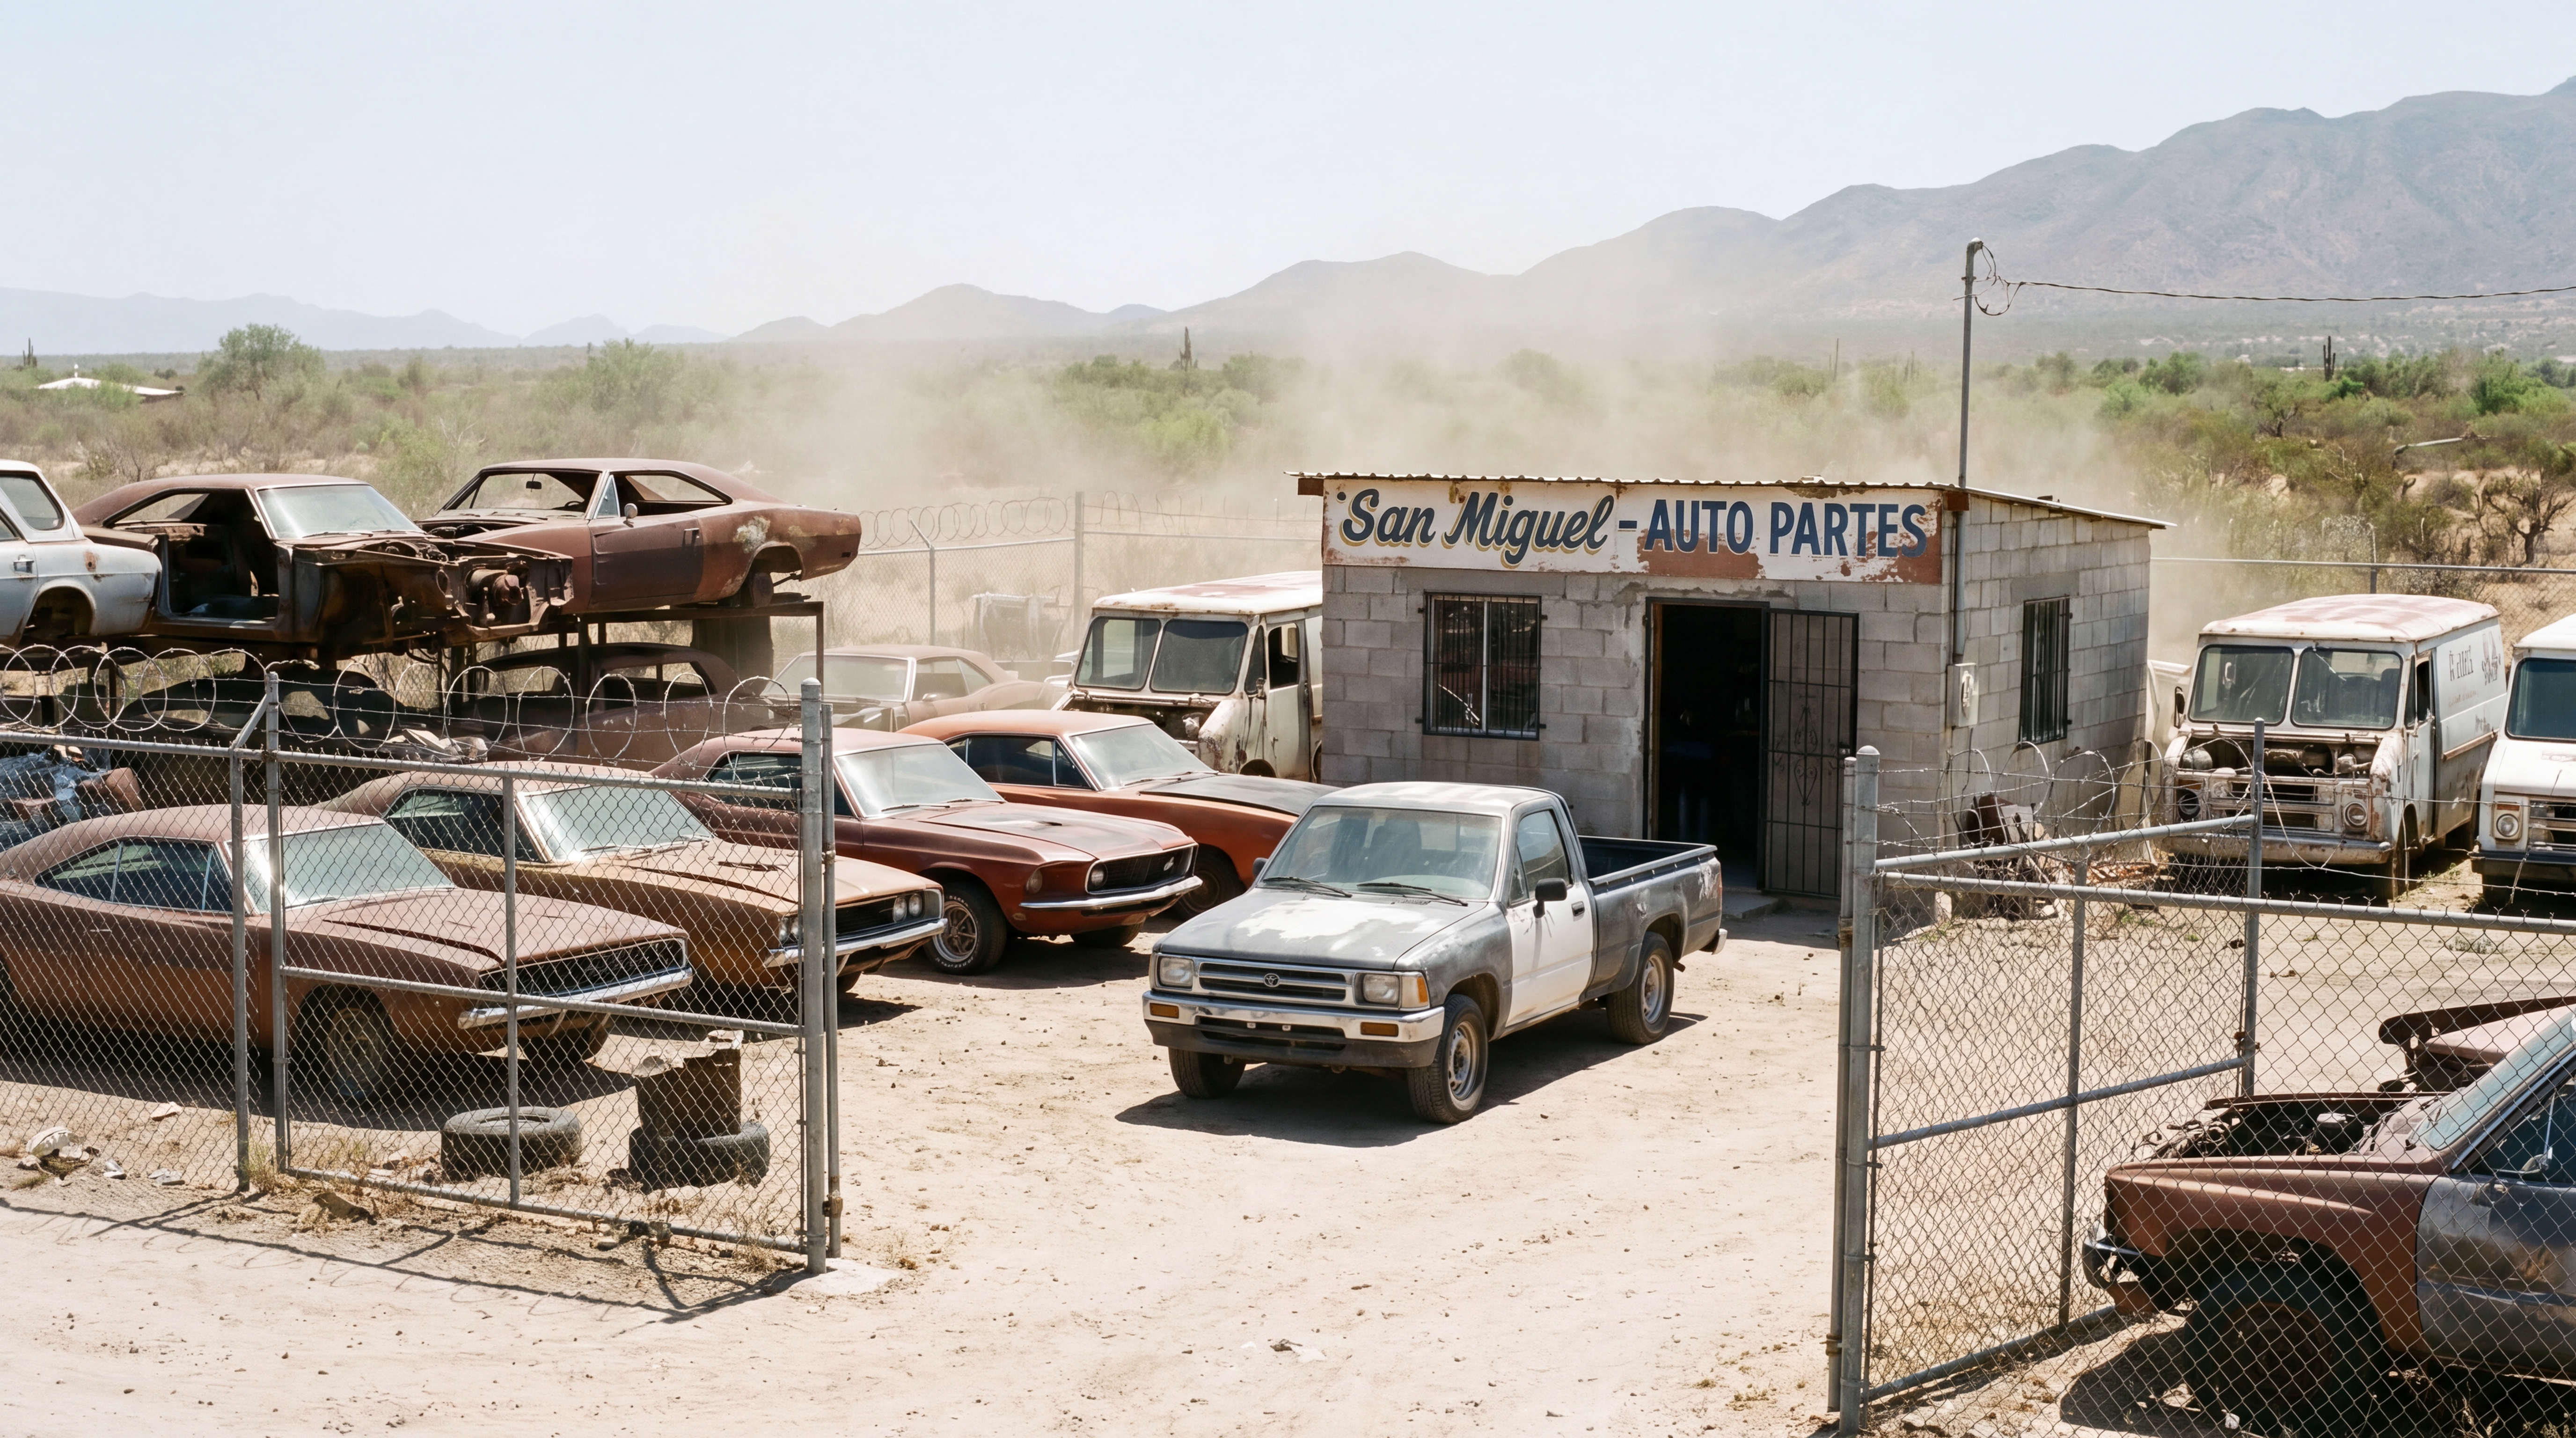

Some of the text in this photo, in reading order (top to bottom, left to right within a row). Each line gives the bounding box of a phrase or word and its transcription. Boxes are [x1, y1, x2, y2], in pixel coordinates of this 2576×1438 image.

[1339, 488, 1436, 547] San
[1441, 492, 1615, 569] Miguel
[1643, 499, 1754, 554] AUTO
[1769, 502, 1927, 558] PARTES
